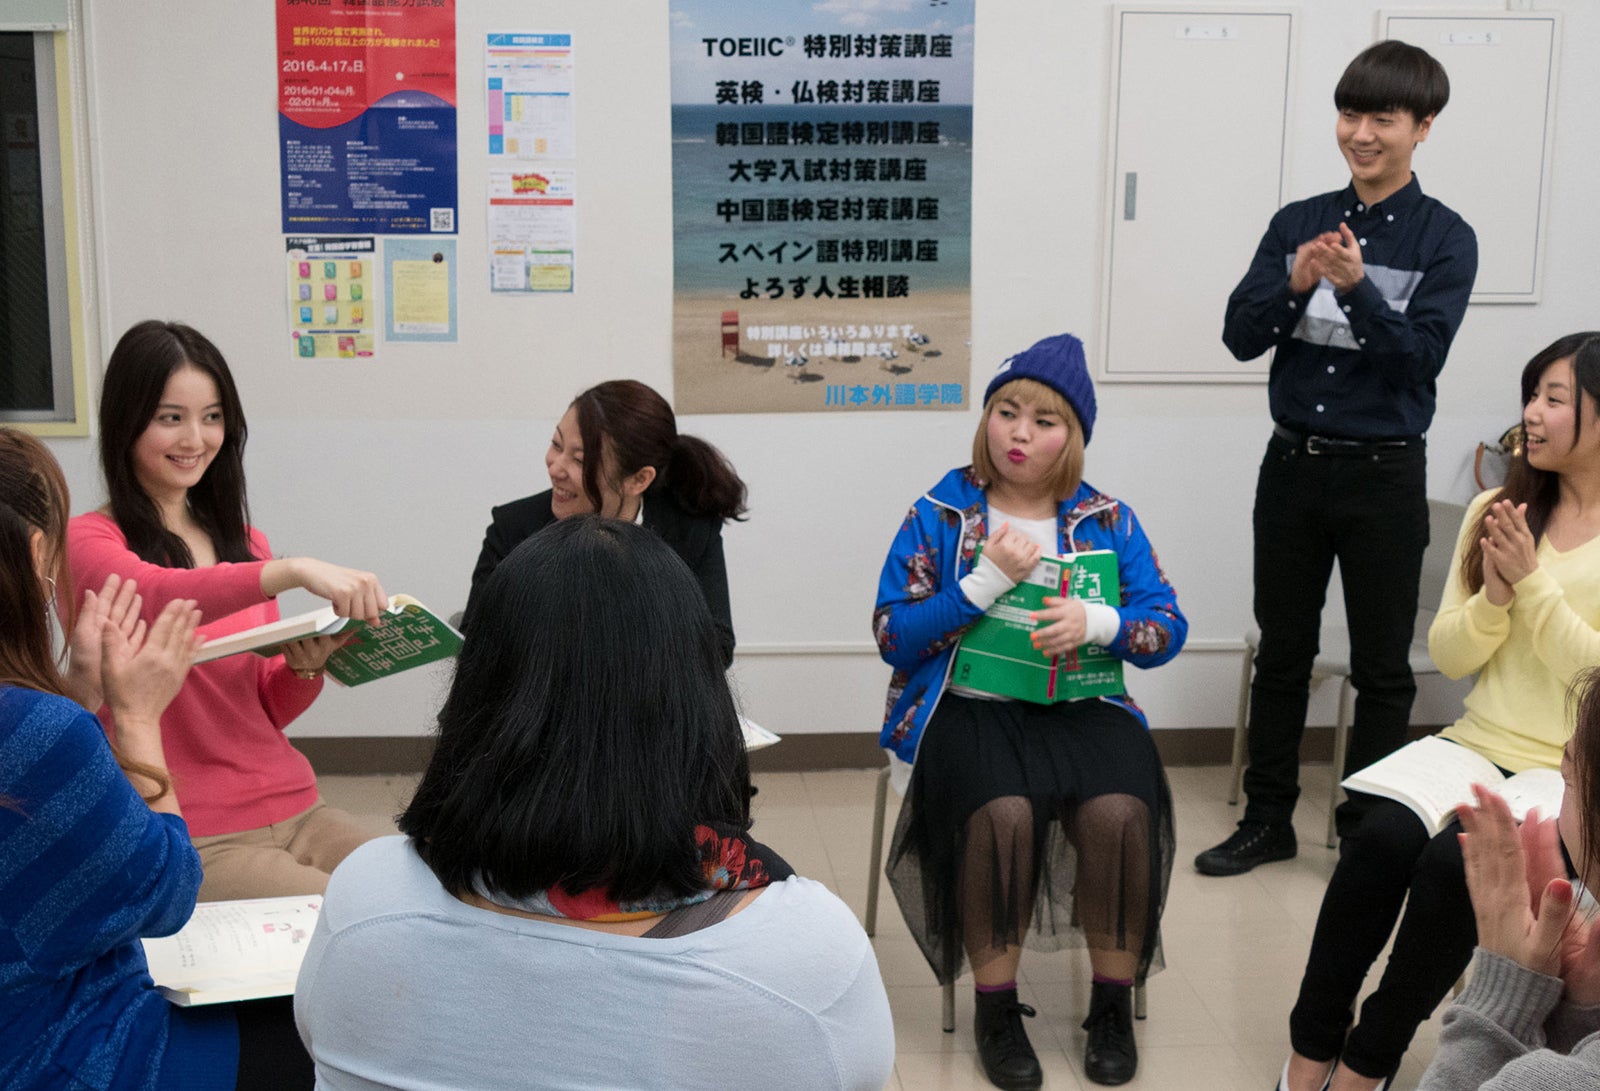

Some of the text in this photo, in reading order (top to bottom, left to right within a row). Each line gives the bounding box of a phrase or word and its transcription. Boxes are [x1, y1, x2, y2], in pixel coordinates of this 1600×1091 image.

[803, 34, 953, 58] 特別対策講座
[715, 80, 940, 104] 英検・仏検対策講座
[716, 121, 940, 146] 韓国語検定特別講座
[728, 158, 928, 182] 大学入試対策講座
[717, 197, 939, 222] 中国語検定対策講座
[718, 239, 939, 264] スペイン語特別講座
[739, 275, 910, 300] よろず人生相談
[825, 383, 963, 407] 川本外語学院
